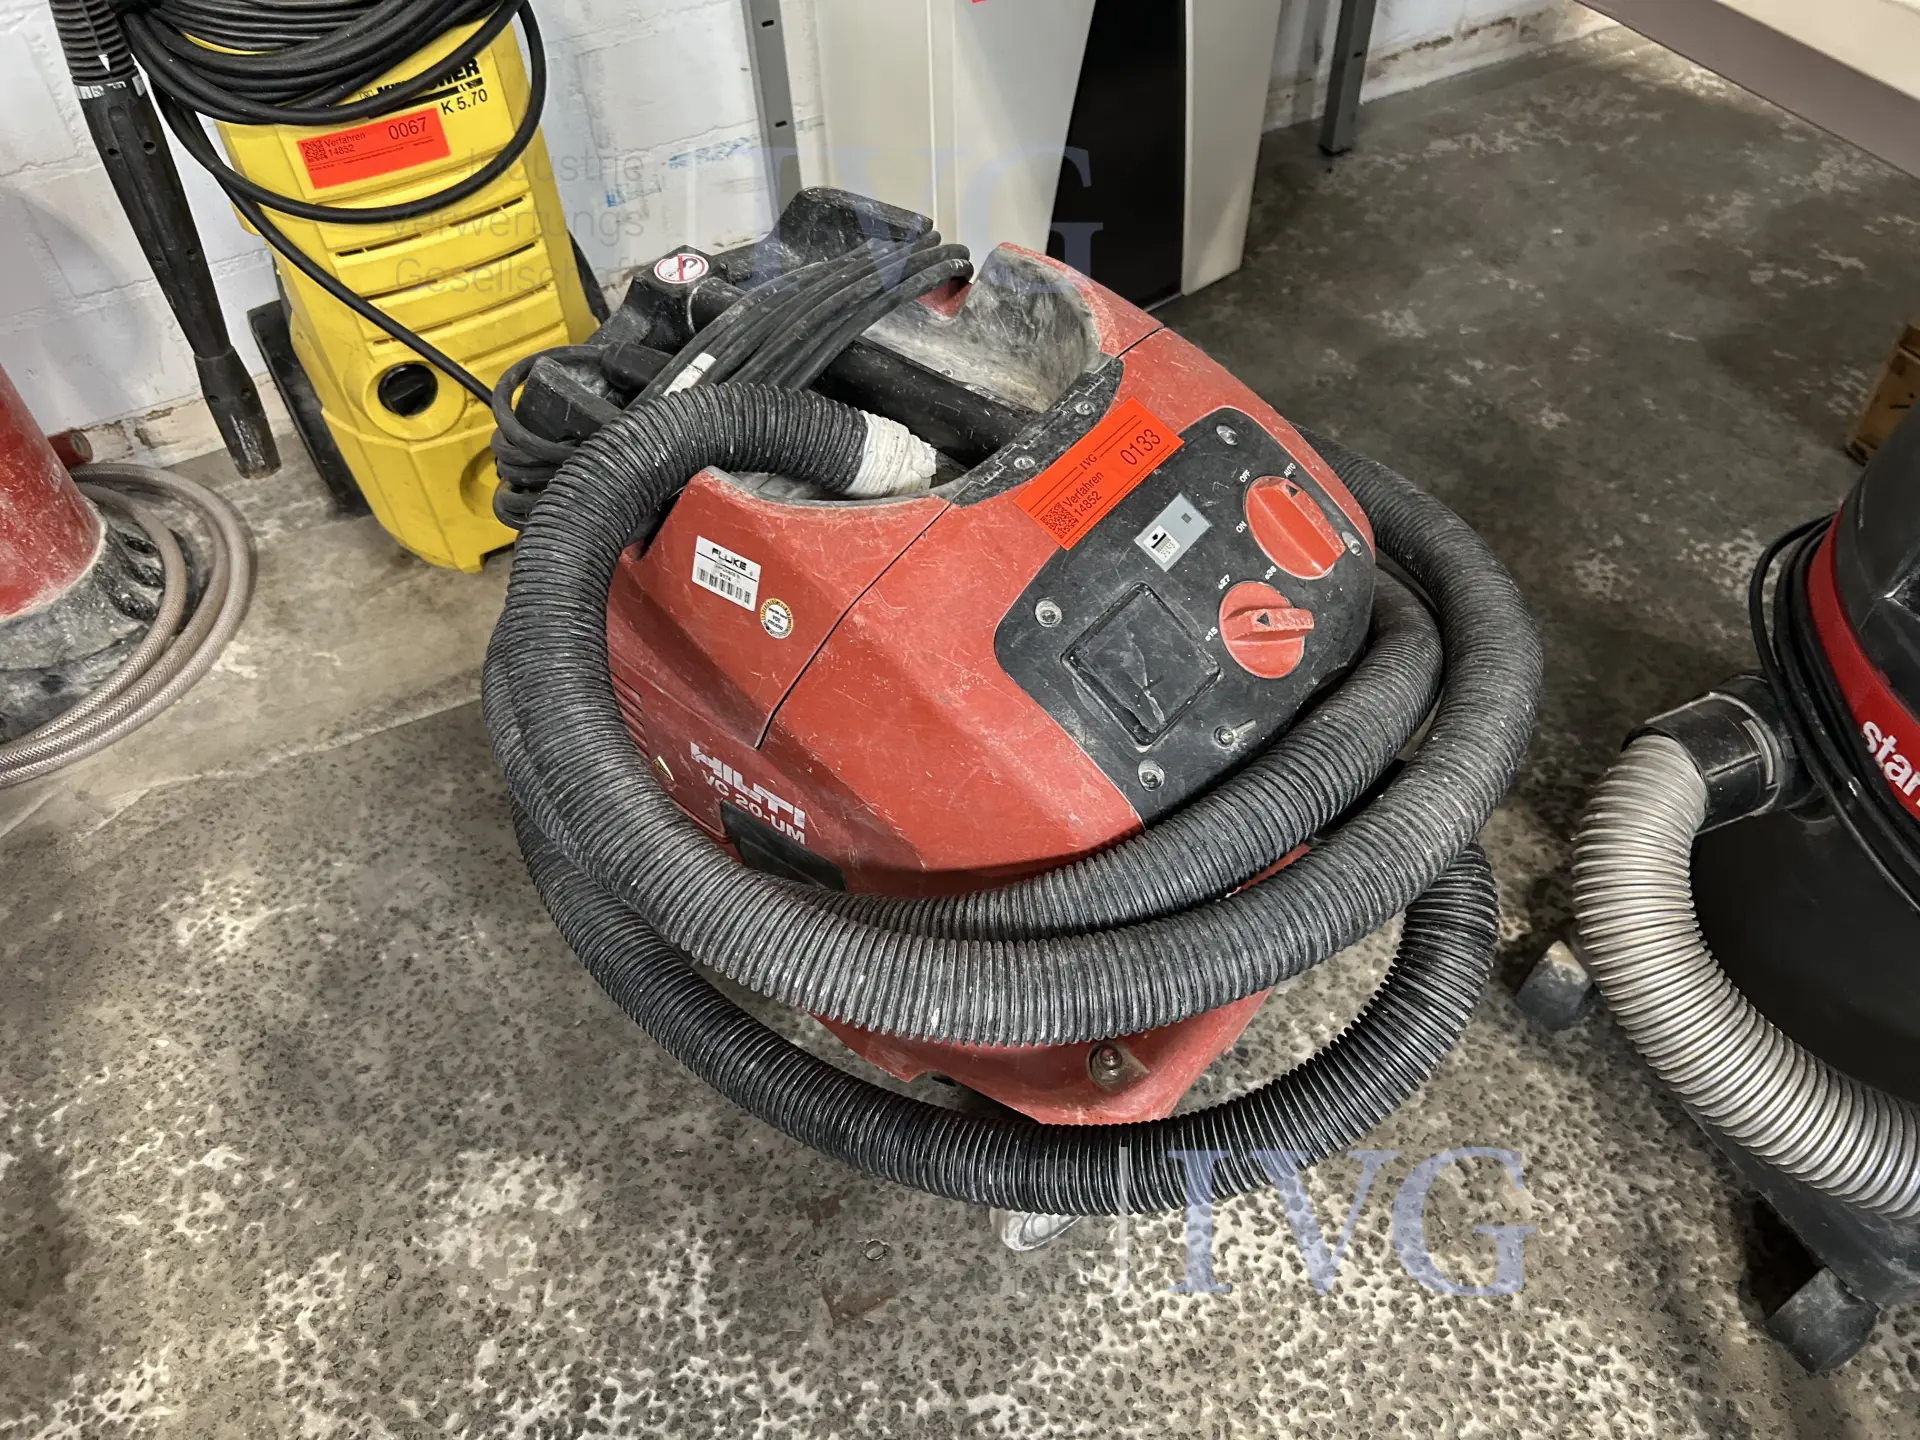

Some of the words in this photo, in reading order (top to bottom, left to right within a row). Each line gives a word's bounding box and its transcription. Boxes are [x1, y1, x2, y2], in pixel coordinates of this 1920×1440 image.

[440, 100, 455, 116] K
[456, 88, 488, 111] 5.70
[324, 131, 366, 149] Verfahren
[388, 116, 427, 141] 0067
[327, 144, 356, 158] 14852
[1119, 428, 1161, 466] 0133
[1079, 453, 1098, 471] IVG
[1283, 462, 1297, 478] AUTO
[1239, 469, 1251, 483] OFF
[1062, 471, 1105, 508] Verfahren
[1073, 490, 1103, 517] 14852
[1235, 520, 1248, 534] ON
[711, 547, 747, 571] FLUKE
[690, 742, 806, 830] HILTI
[701, 769, 730, 797] VC
[734, 793, 806, 845] 20-UM
